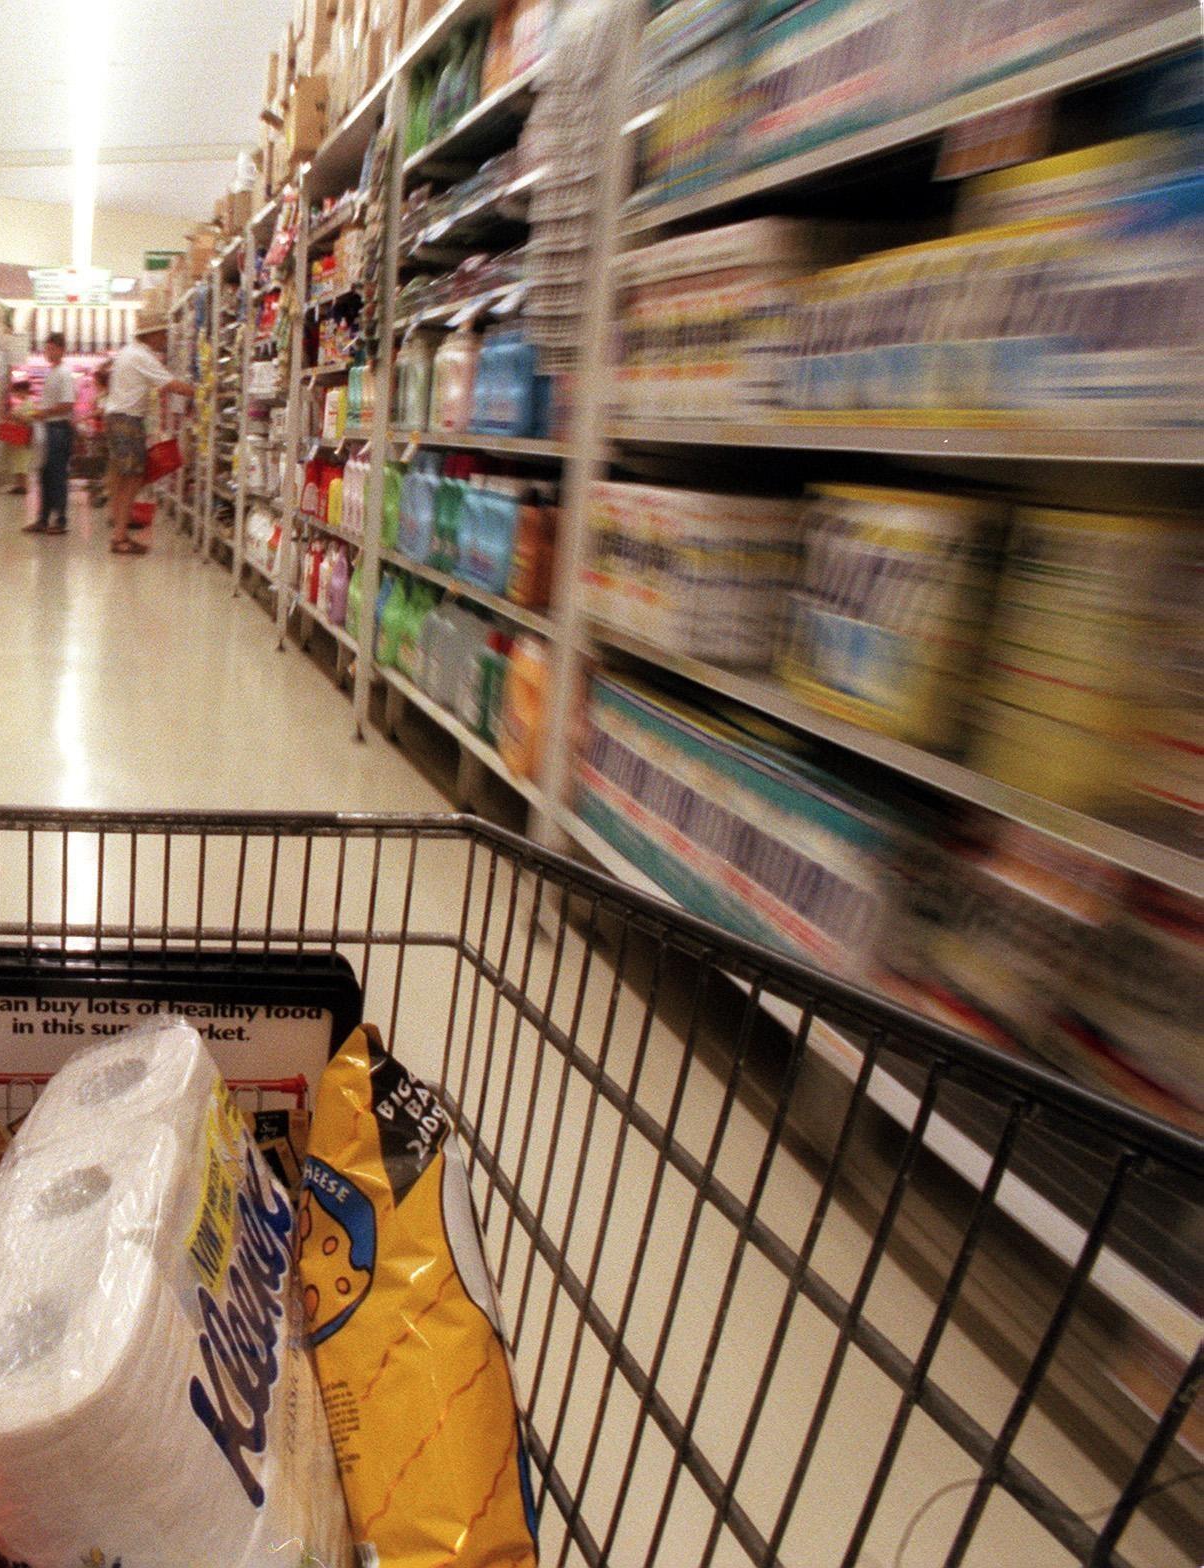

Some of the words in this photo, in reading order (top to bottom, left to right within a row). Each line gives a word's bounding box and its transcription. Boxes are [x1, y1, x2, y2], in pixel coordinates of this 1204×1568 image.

[36, 996, 81, 1016] buy
[87, 996, 131, 1014] lots
[136, 999, 163, 1015] of
[167, 1000, 259, 1022] healthy
[264, 1004, 323, 1020] food
[12, 1018, 34, 1034] in
[42, 1017, 86, 1035] this
[90, 1023, 251, 1041] surket.
[404, 1088, 432, 1120] BA
[303, 1163, 351, 1203] HEESE
